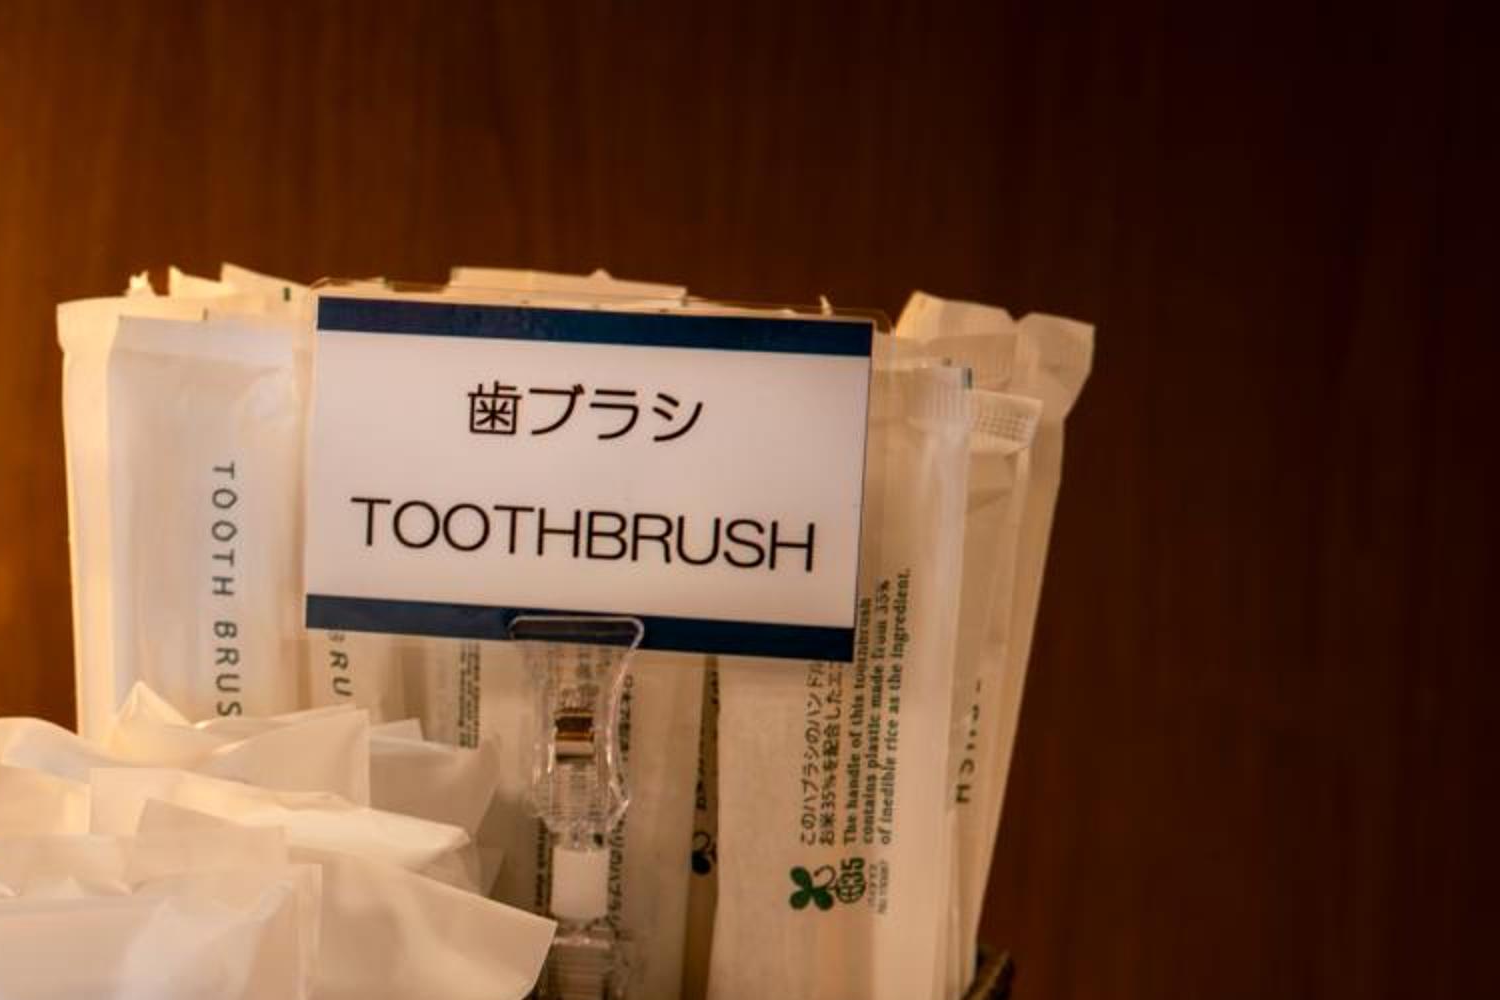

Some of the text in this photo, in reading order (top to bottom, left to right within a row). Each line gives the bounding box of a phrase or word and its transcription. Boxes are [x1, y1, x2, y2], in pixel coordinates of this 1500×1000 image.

[467, 380, 703, 442] 歯ブラシ
[351, 497, 816, 572] TOOTHBRUSH
[211, 461, 242, 718] TOOTH BRUS
[870, 666, 883, 708] made
[887, 664, 902, 690] the
[850, 694, 864, 725] this
[889, 696, 900, 715] as
[849, 731, 862, 749] of
[865, 714, 883, 769] plastic
[884, 719, 898, 751] rice
[846, 753, 861, 809] handle
[880, 757, 896, 824] inedible
[843, 814, 858, 846] The
[862, 775, 877, 844] contains
[877, 826, 891, 845] of
